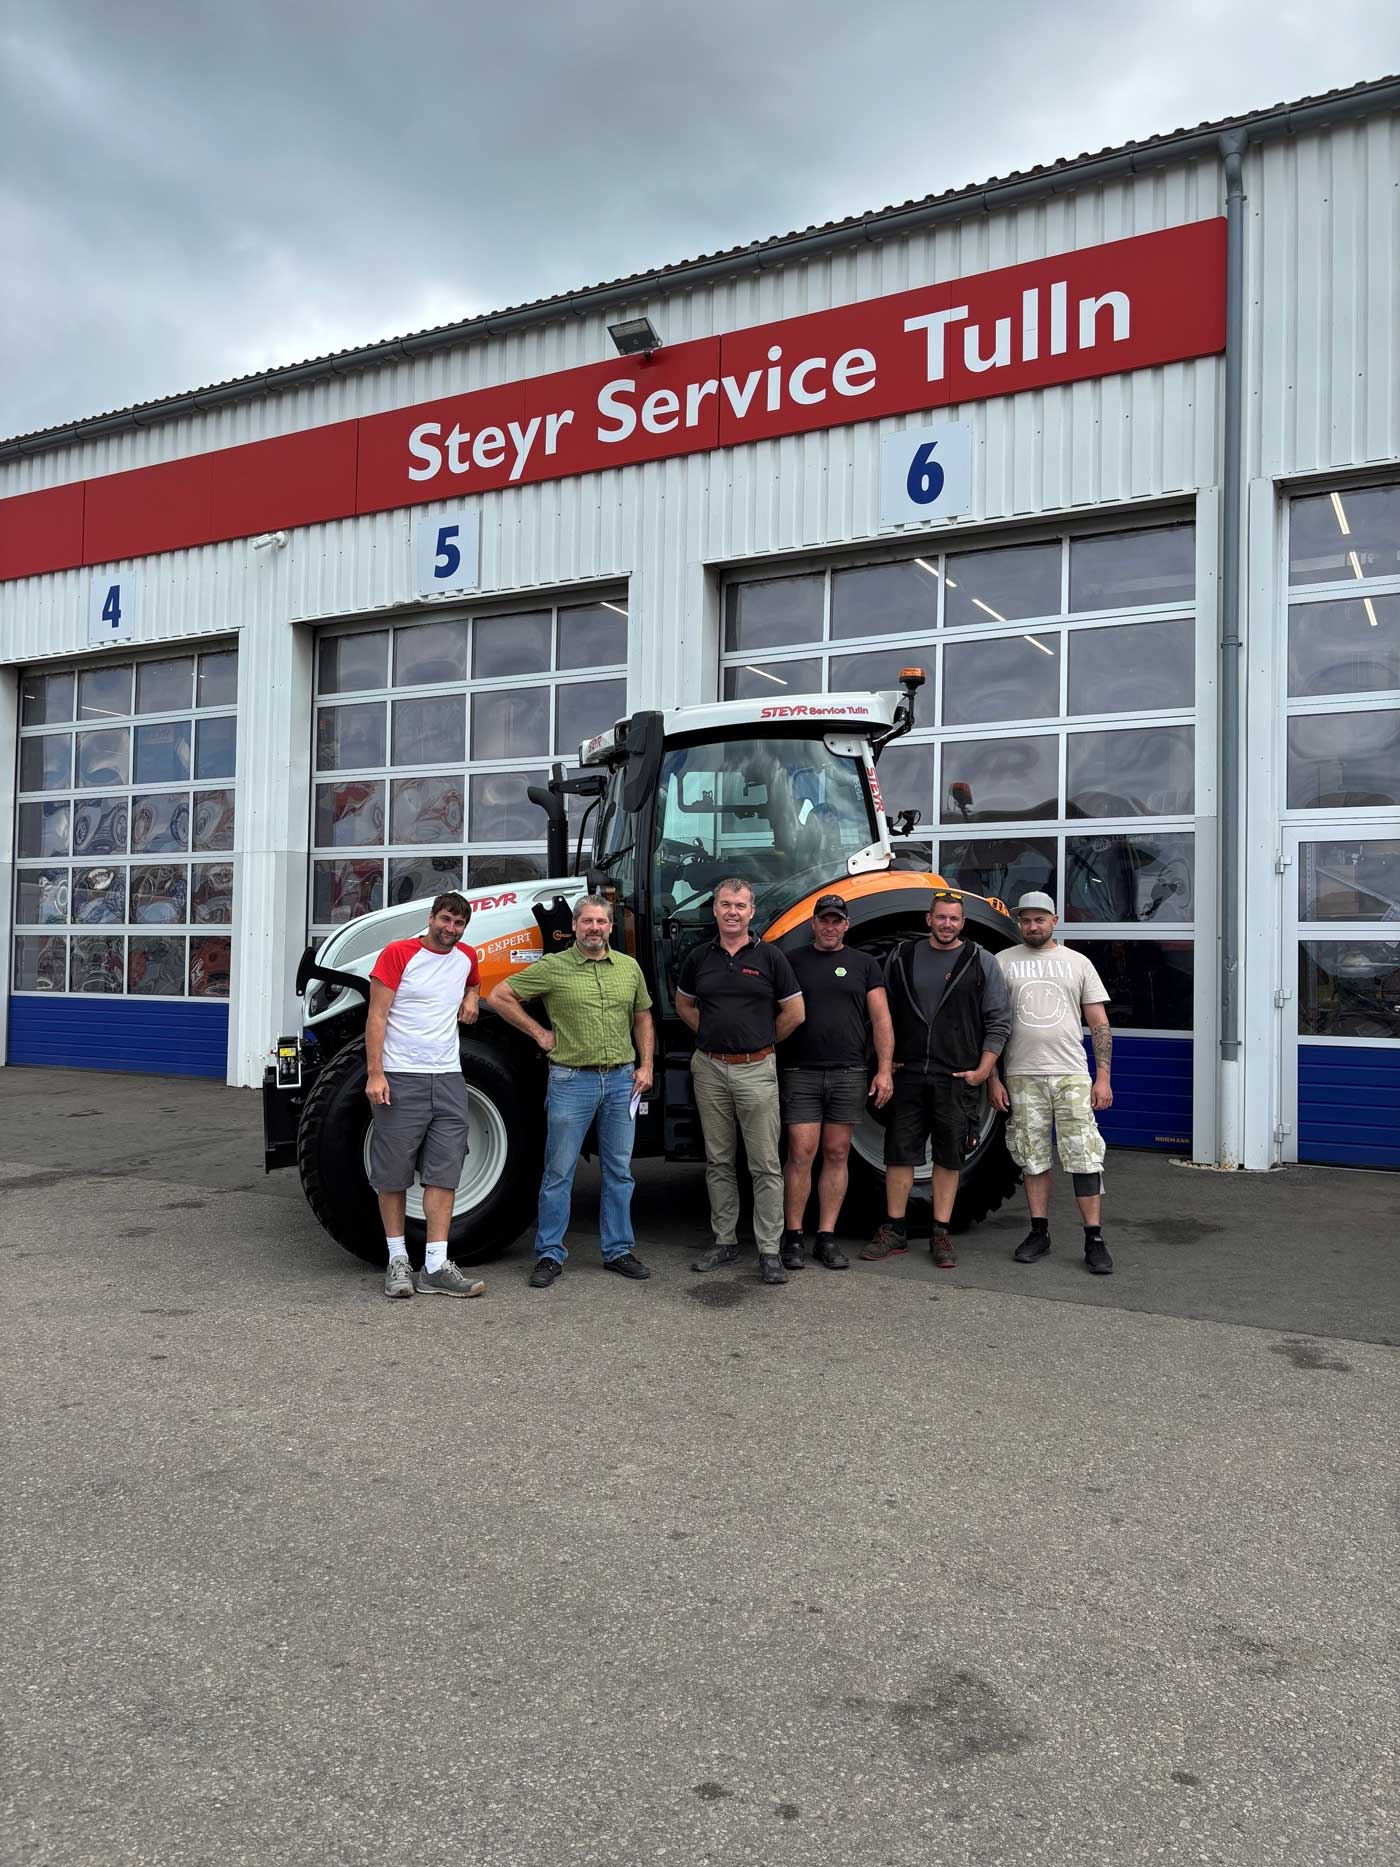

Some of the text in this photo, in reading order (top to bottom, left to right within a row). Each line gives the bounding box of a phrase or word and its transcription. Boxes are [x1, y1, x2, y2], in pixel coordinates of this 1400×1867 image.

[408, 280, 1131, 482] Steyr Service Tulln
[906, 440, 945, 505] 6
[432, 524, 461, 579] 5
[101, 584, 122, 629] 4
[760, 705, 869, 719] STEYR Service Tulln
[866, 767, 885, 812] STEYR
[469, 892, 517, 912] TEYR
[487, 932, 531, 953] EXPERT
[1008, 959, 1073, 979] NIRVANA
